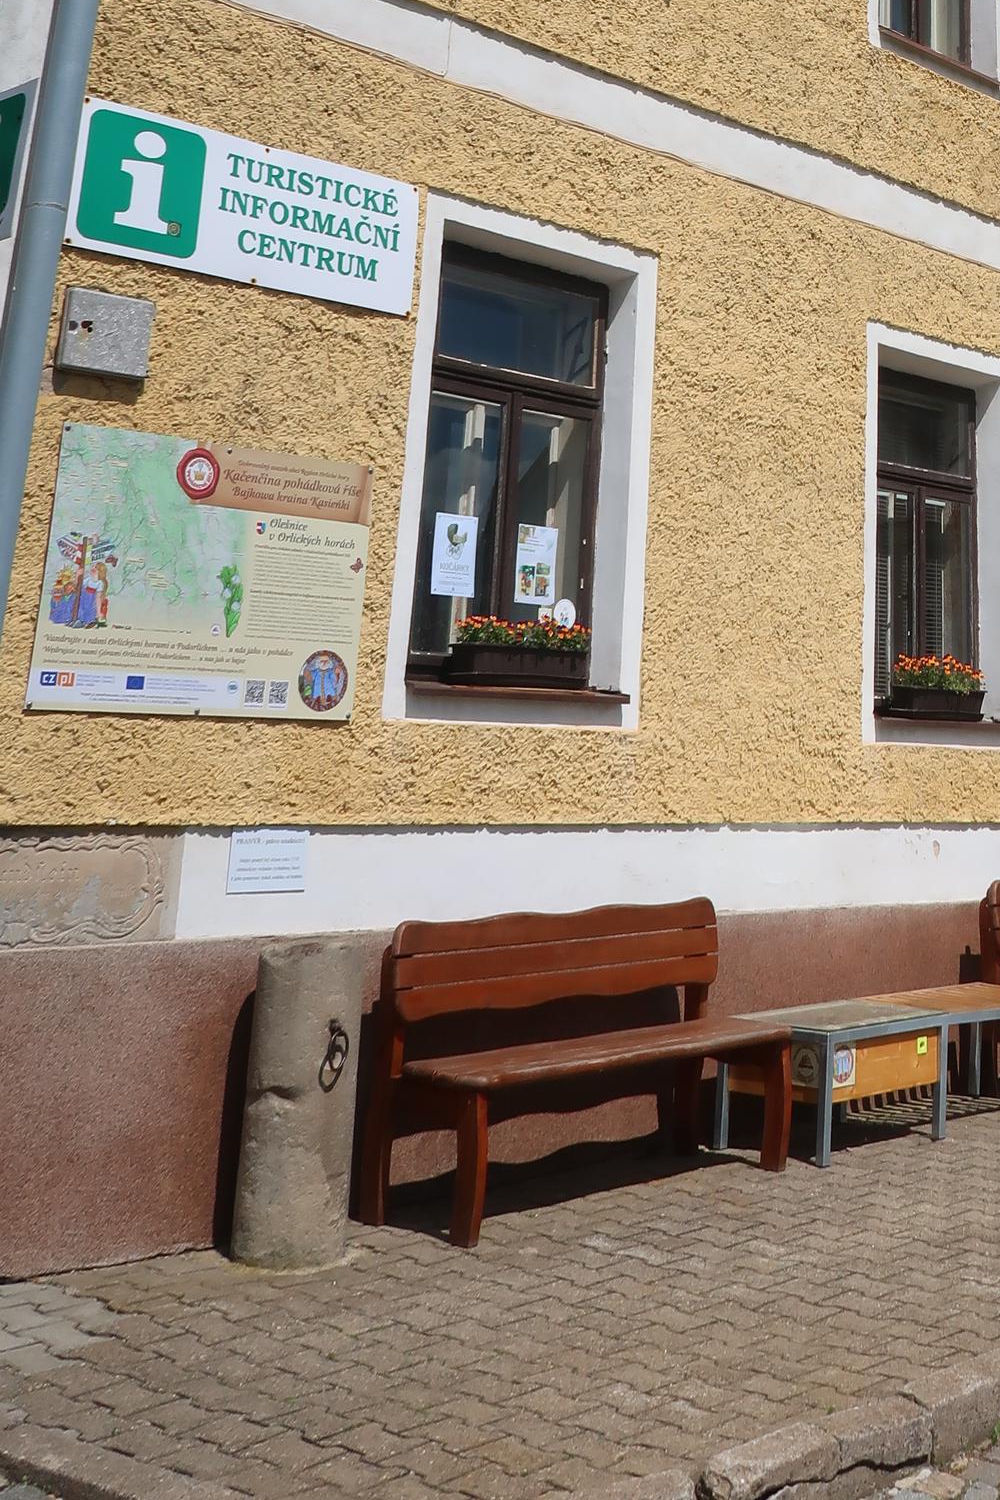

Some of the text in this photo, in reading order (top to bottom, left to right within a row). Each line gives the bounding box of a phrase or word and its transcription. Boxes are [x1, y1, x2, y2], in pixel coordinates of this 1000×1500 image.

[227, 153, 398, 217] TURISTICKÉ
[218, 187, 400, 252] INFORMAČNÍ
[237, 229, 379, 282] CENTRUM
[224, 468, 282, 486] Kačenčina
[283, 479, 342, 495] pohádková
[342, 485, 362, 498] říše
[232, 486, 275, 500] Bajkowa
[276, 491, 308, 504] kraina
[270, 518, 308, 532] Olešnice
[269, 532, 356, 550] v Orlických horách
